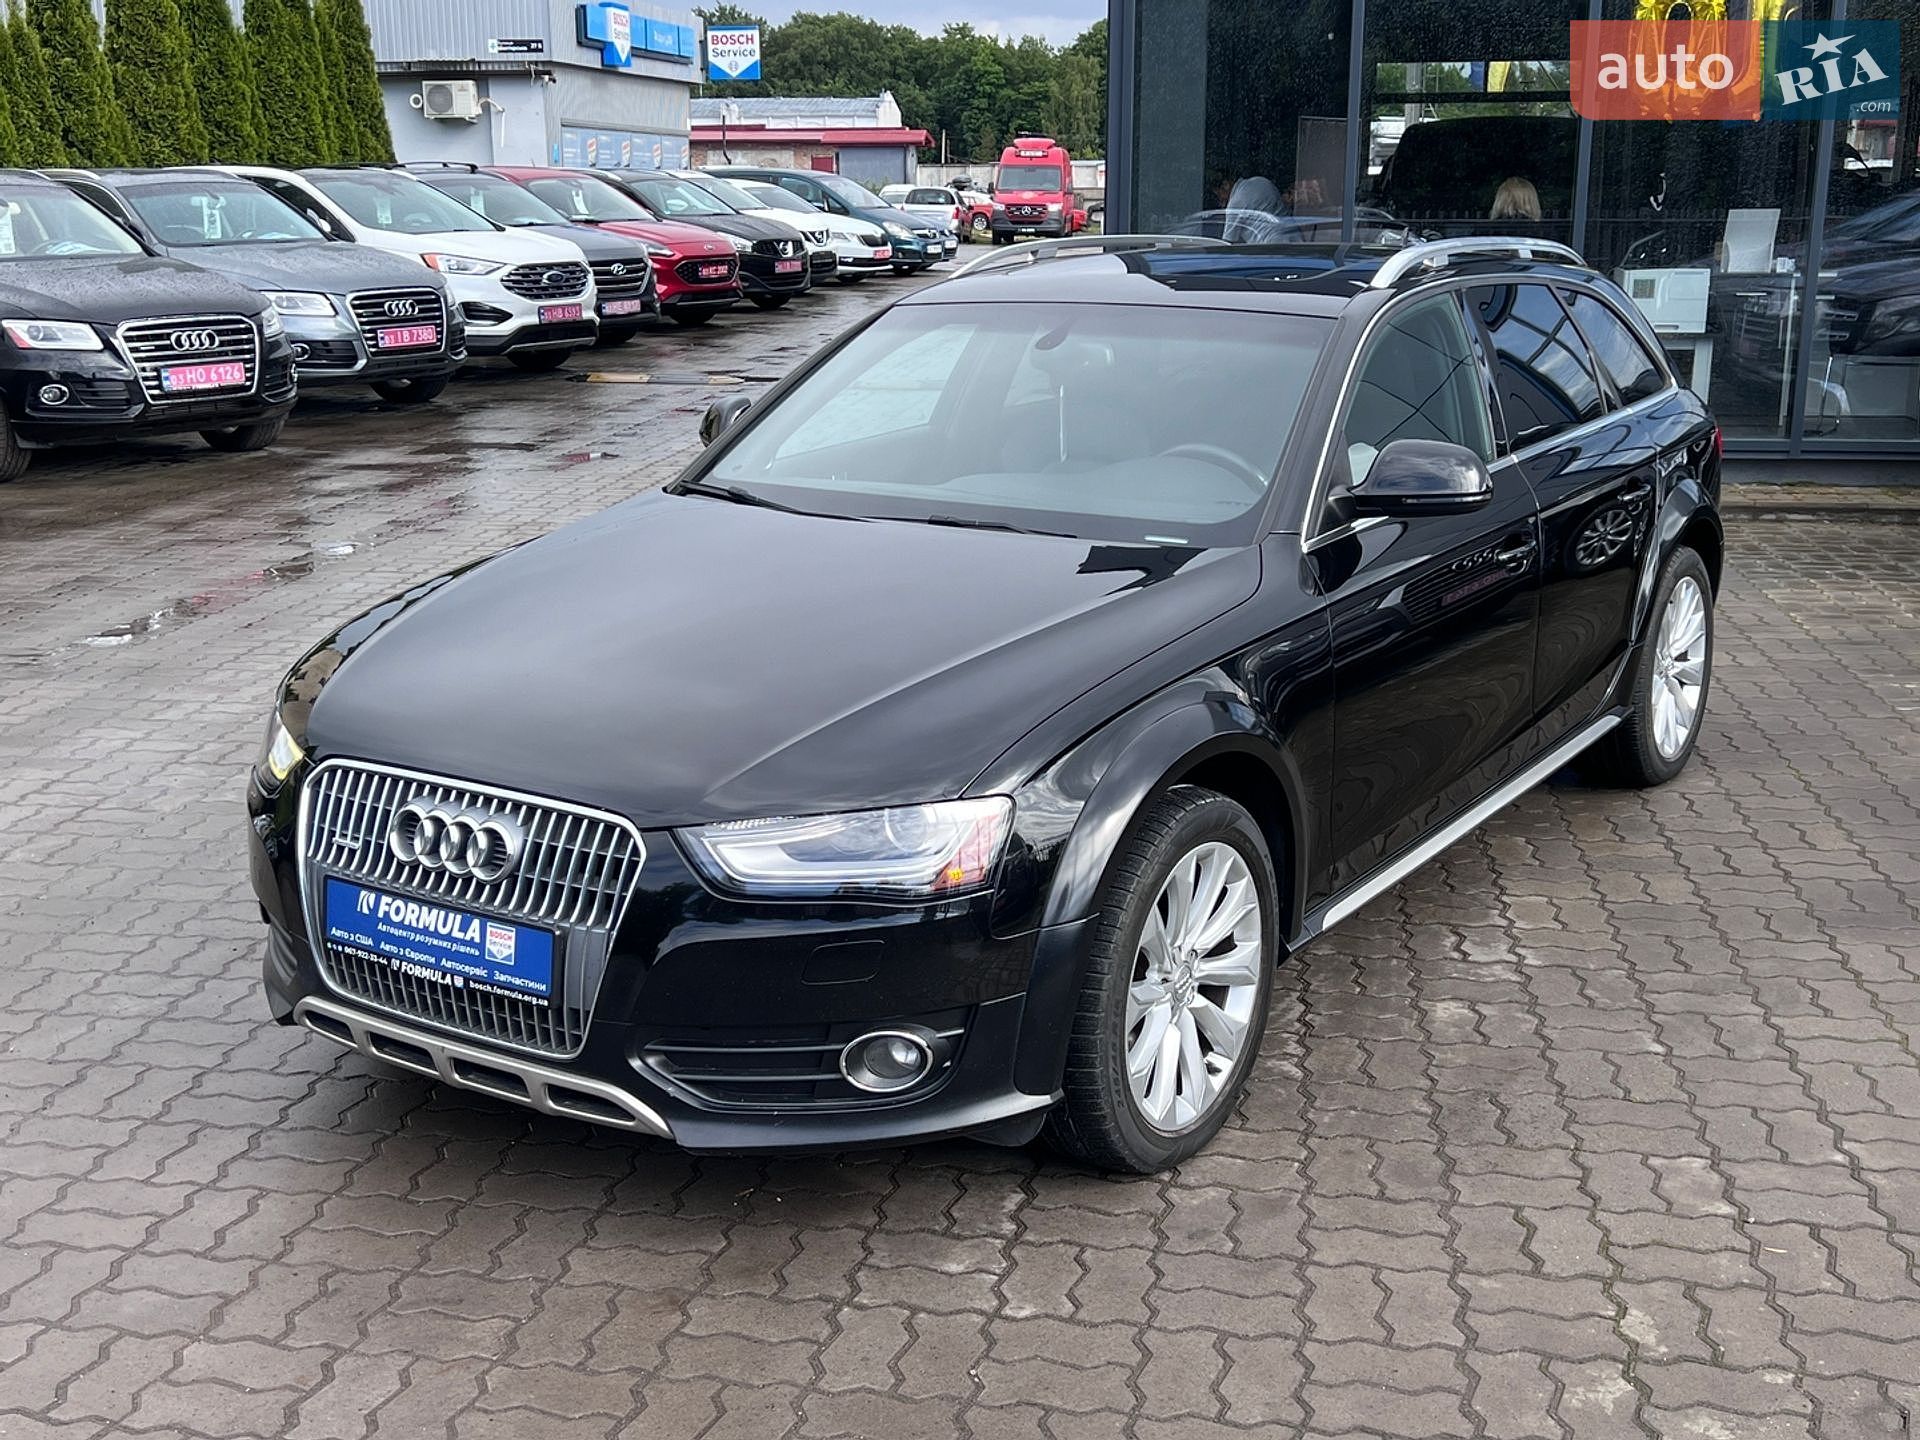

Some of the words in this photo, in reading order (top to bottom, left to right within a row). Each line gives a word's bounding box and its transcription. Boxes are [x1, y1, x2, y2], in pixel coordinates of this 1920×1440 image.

[711, 33, 754, 45] BOSCH
[711, 47, 756, 58] Service
[210, 366, 241, 381] 6126
[377, 895, 481, 943] FORMULA
[330, 927, 349, 939] Авто
[355, 933, 374, 946] США
[377, 922, 415, 942] Автоцентр
[414, 931, 451, 949] розумних
[451, 941, 480, 956] рішень
[489, 930, 513, 942] BOSCH
[489, 938, 512, 950] Service
[380, 941, 398, 954] Авто
[404, 949, 436, 964] Європи
[401, 961, 452, 986] FORMULA
[440, 957, 488, 978] Автосервіс
[493, 970, 547, 992] Запчастини
[469, 980, 549, 1007] bosch.formula.org.ua
